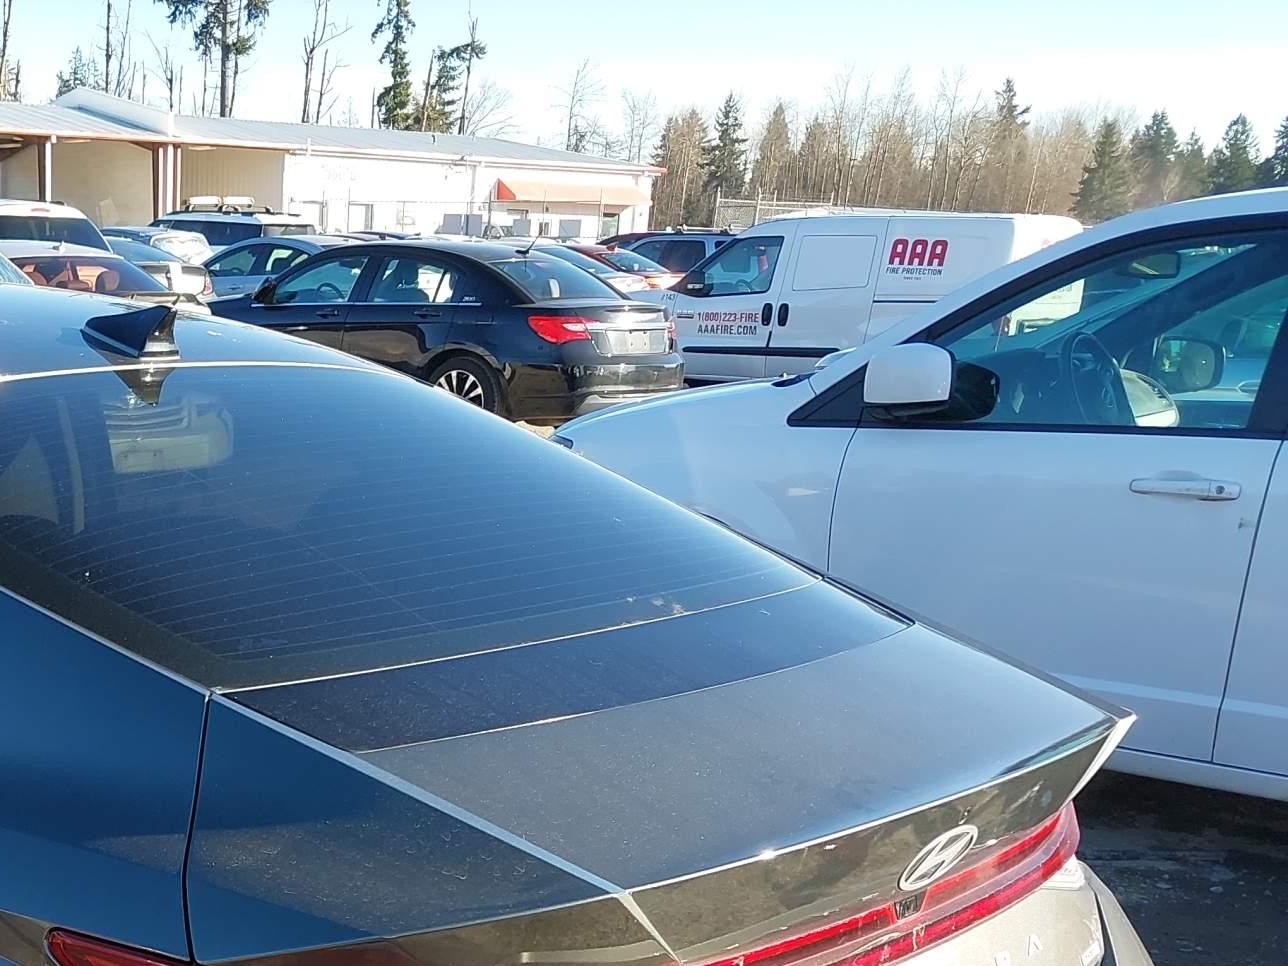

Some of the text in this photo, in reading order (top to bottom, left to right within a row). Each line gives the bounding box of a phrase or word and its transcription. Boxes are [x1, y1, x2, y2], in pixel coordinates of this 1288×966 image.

[888, 239, 948, 266] AAA
[886, 266, 943, 275] FIRE PROTECTION
[697, 324, 757, 335] AAAFIRE.COM
